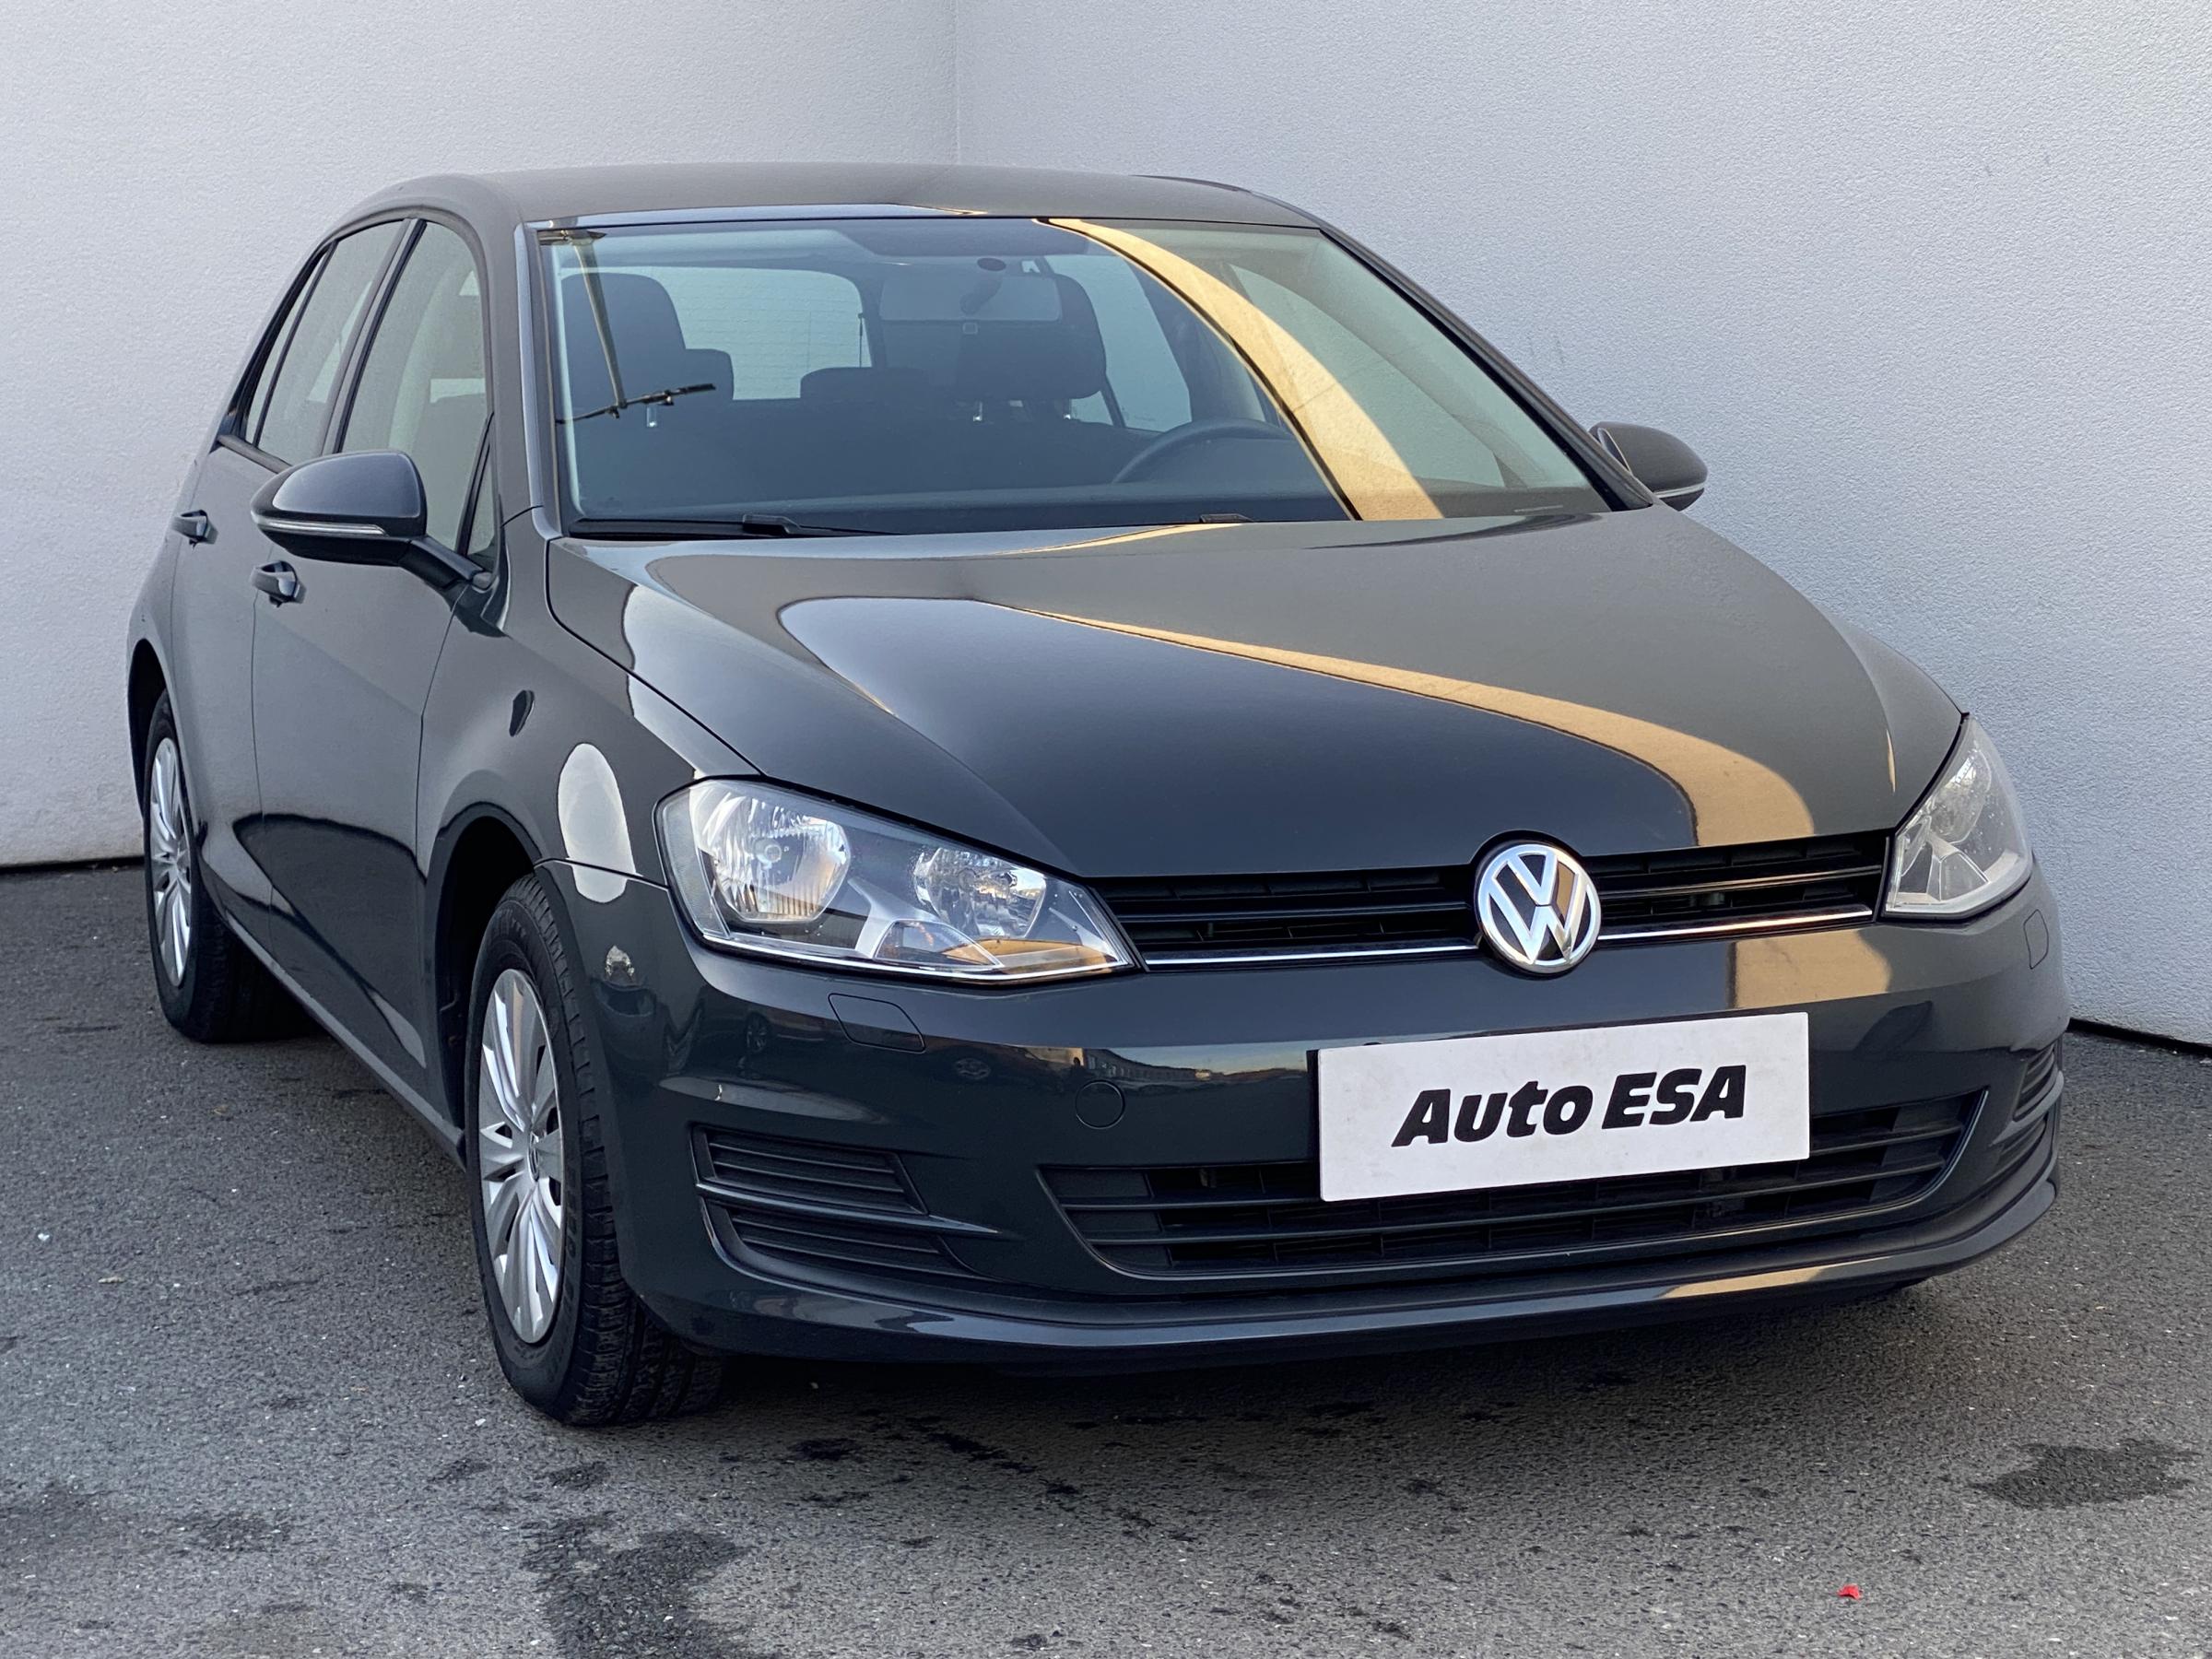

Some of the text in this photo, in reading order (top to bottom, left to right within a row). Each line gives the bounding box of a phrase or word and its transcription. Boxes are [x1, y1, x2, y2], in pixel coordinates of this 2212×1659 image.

[1482, 845, 1595, 969] VW
[1391, 1065, 1747, 1147] Auto ESA
